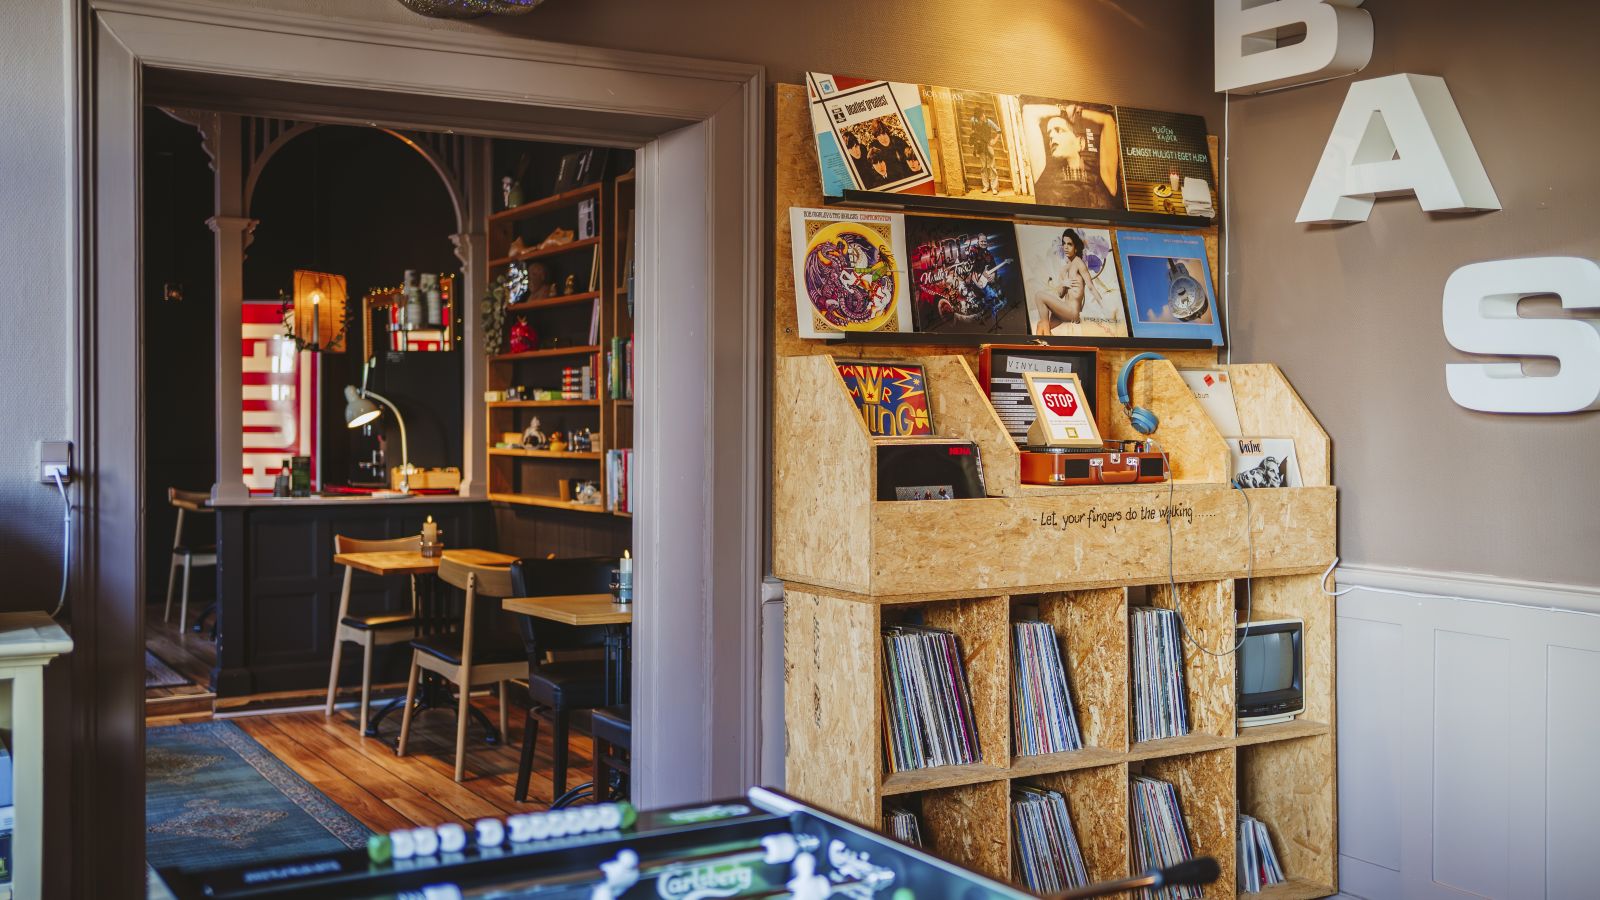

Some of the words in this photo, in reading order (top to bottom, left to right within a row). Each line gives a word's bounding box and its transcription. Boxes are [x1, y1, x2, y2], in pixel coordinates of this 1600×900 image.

[1008, 360, 1039, 372] VINYL
[1046, 365, 1064, 374] BAR
[1044, 393, 1074, 408] STOP
[1040, 511, 1058, 526] Let
[1062, 514, 1086, 531] your
[1087, 506, 1122, 529] fingers
[1125, 507, 1138, 521] do
[1141, 506, 1156, 520] the
[657, 864, 752, 899] Carlsberg
